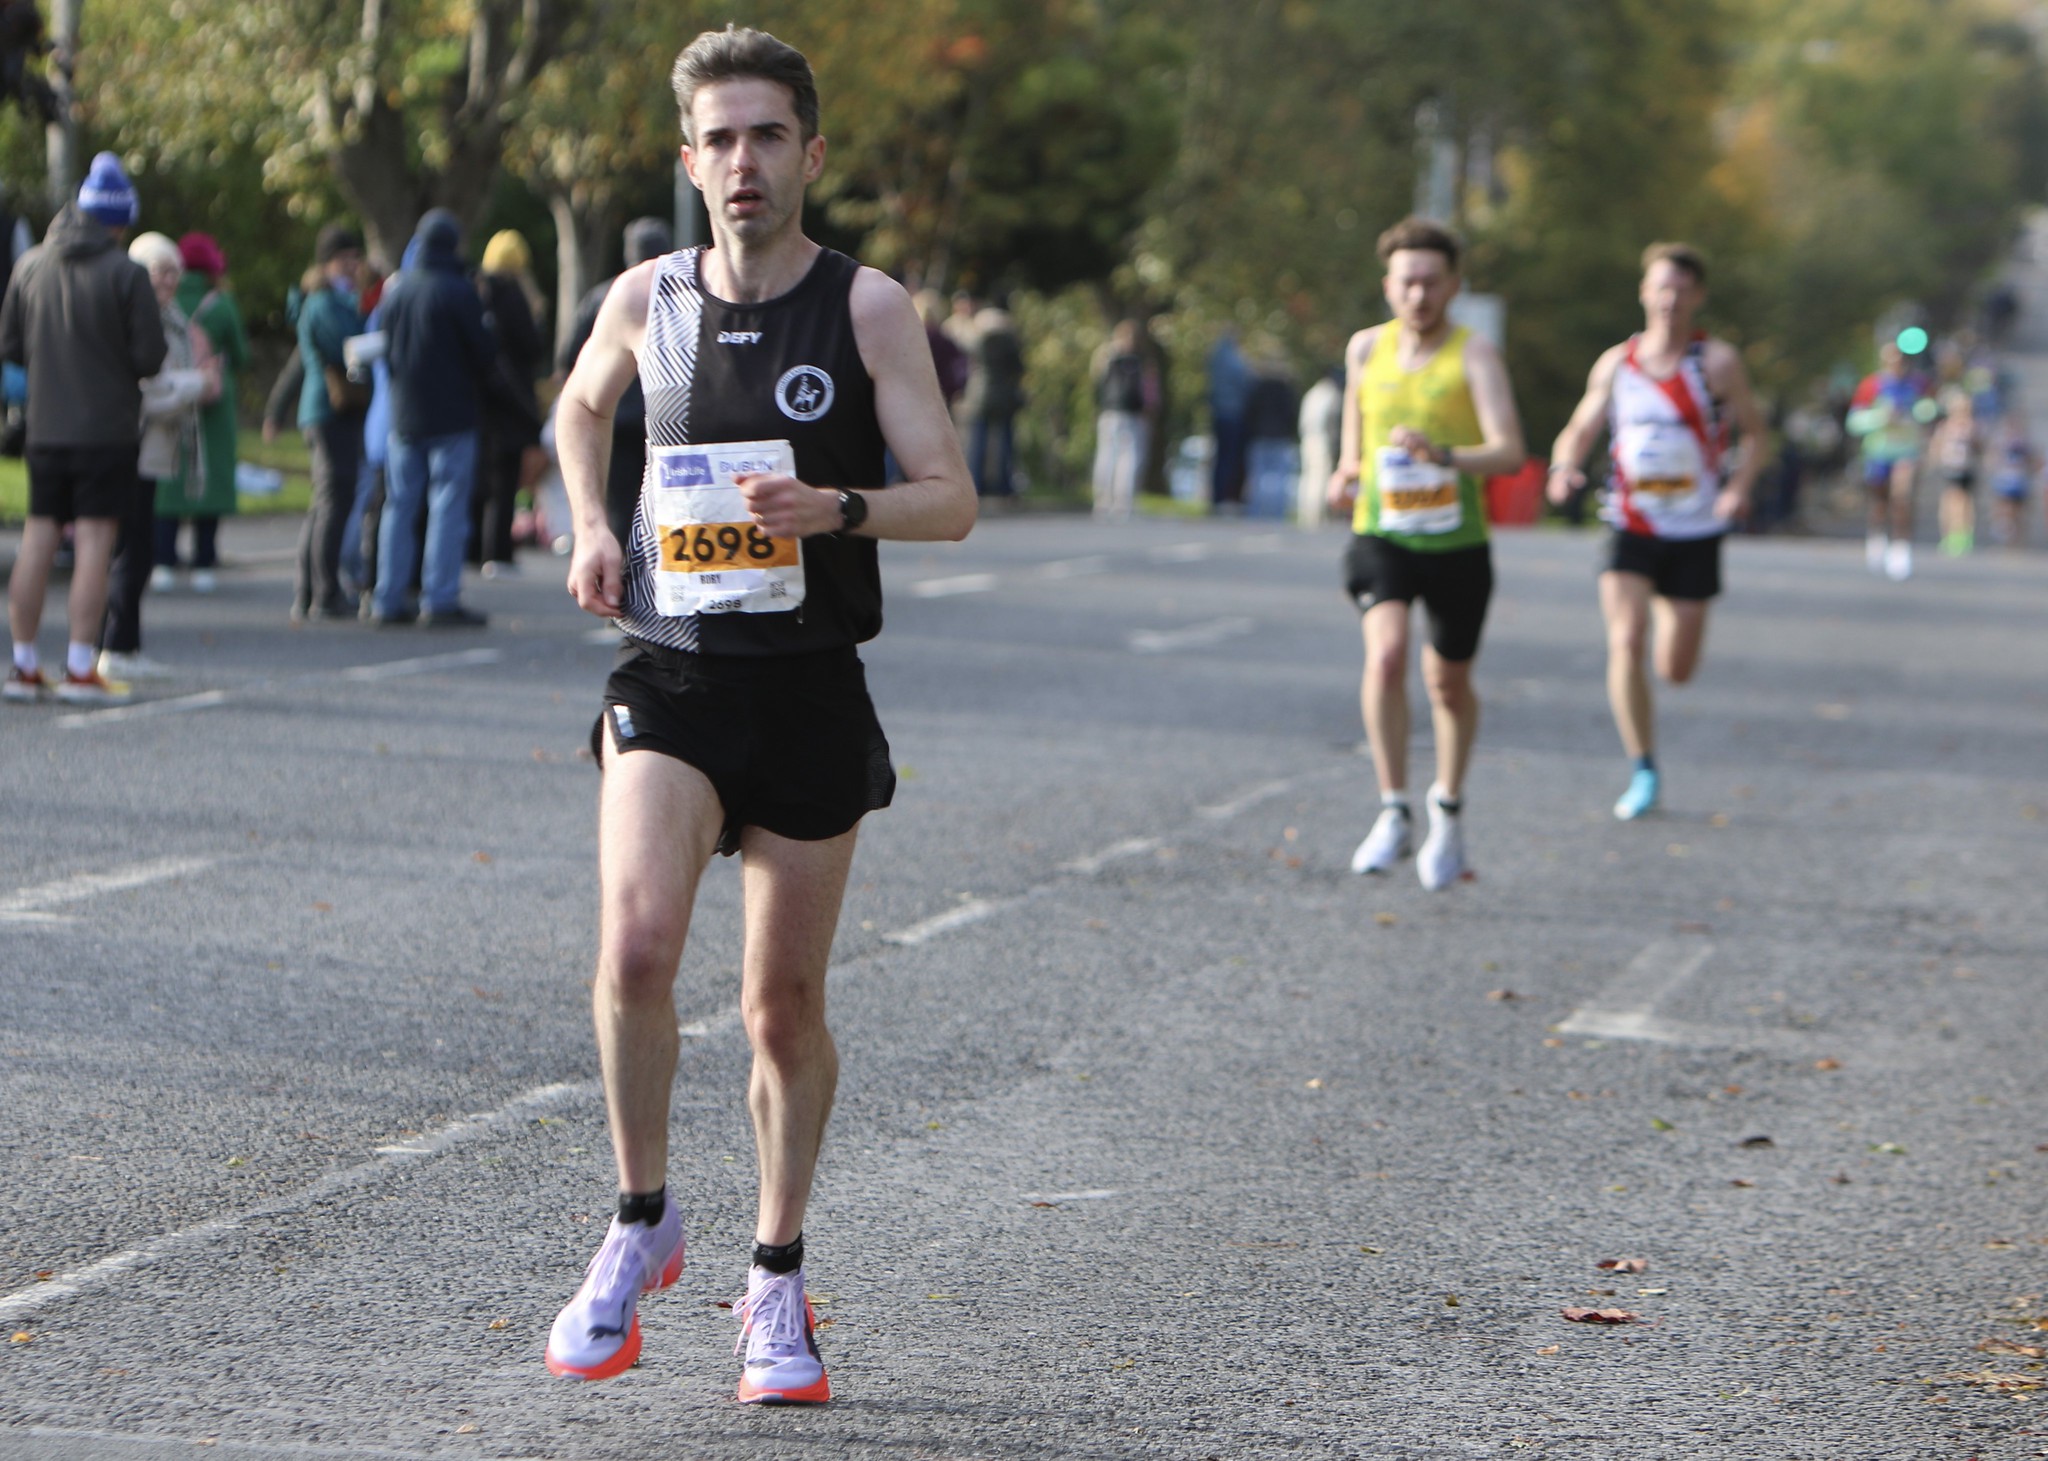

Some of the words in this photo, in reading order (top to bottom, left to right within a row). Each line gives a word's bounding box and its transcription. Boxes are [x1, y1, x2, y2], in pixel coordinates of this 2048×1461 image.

[717, 331, 763, 344] DEFY
[719, 460, 773, 473] DUBLIN
[669, 525, 775, 562] 2698
[709, 599, 742, 610] 2698
